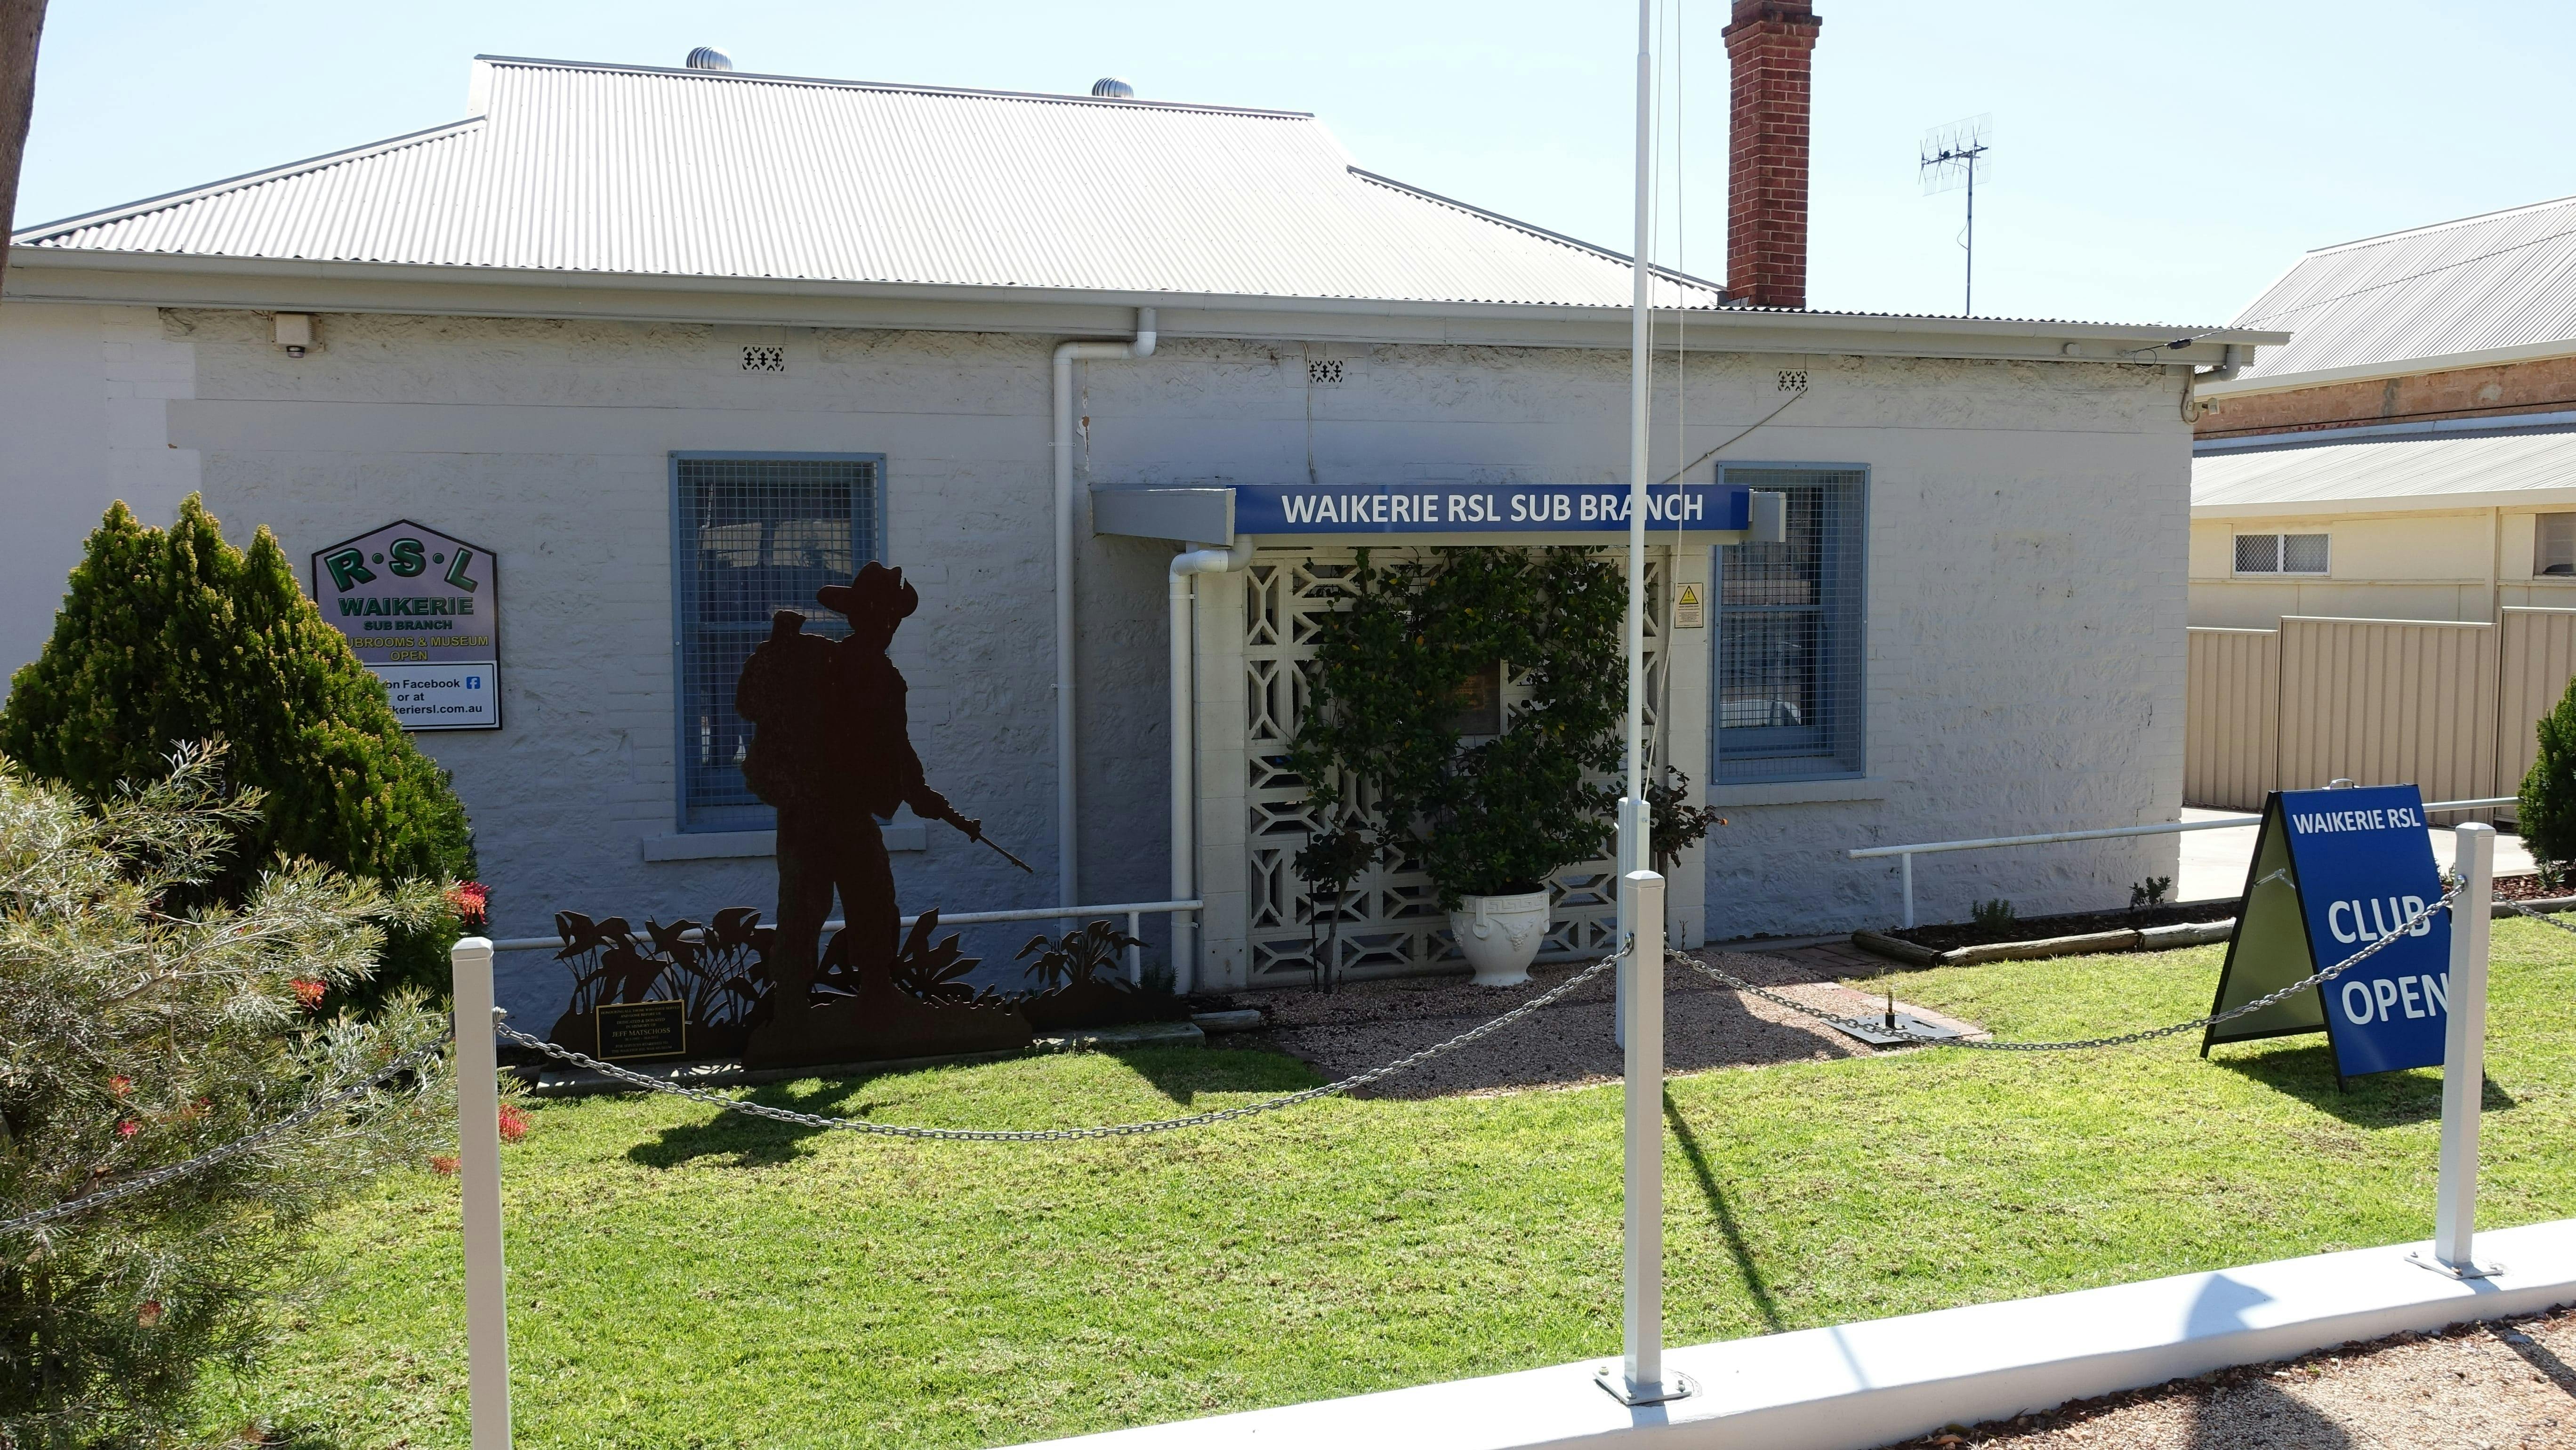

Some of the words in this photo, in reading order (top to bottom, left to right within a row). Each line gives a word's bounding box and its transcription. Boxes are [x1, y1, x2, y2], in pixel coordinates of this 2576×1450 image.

[1281, 493, 1438, 523] WAIKERIE
[1448, 493, 1501, 522] RSL
[1510, 494, 1571, 522] SUB
[1580, 494, 1703, 521] BRANCH
[338, 597, 474, 616] WAIKERIE
[363, 621, 393, 630] SUB
[395, 620, 452, 630] BRANCH
[346, 637, 414, 648] UBROOMS
[418, 637, 427, 647] &
[431, 636, 489, 647] MUSEUM
[390, 651, 428, 661] OPEN
[403, 679, 460, 689] Facebook
[390, 705, 483, 715] keriersl.com.au
[2292, 809, 2385, 835] WAIKERIE
[2387, 807, 2421, 829] RSL
[2328, 895, 2431, 944] CLUB
[2342, 972, 2449, 1025] OPEN
[629, 1027, 671, 1036] MATSCHOSS
